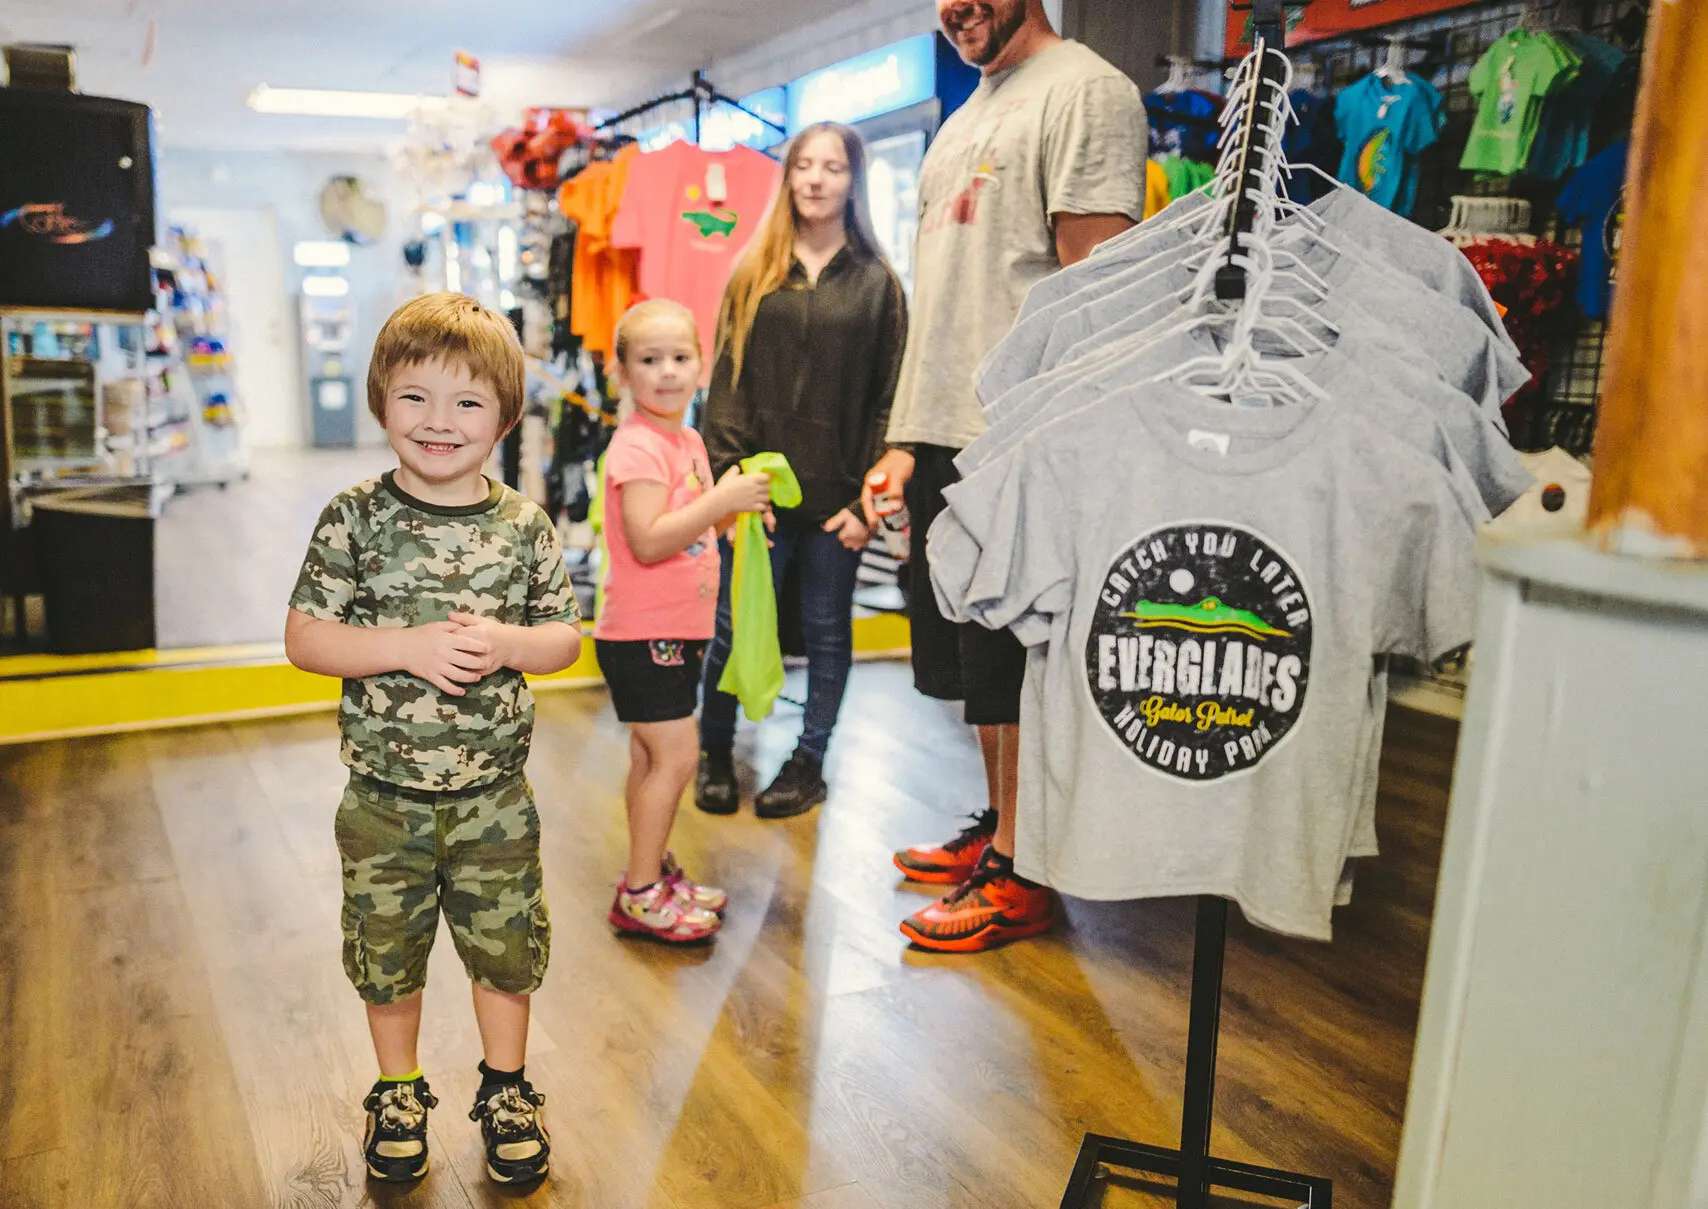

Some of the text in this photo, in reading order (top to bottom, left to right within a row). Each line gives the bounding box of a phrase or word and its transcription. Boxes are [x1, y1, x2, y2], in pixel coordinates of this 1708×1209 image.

[1101, 532, 1309, 627] CATCH YOU LATER
[1098, 634, 1301, 713] EVERGLADES
[1114, 701, 1209, 774] HOLIDAY
